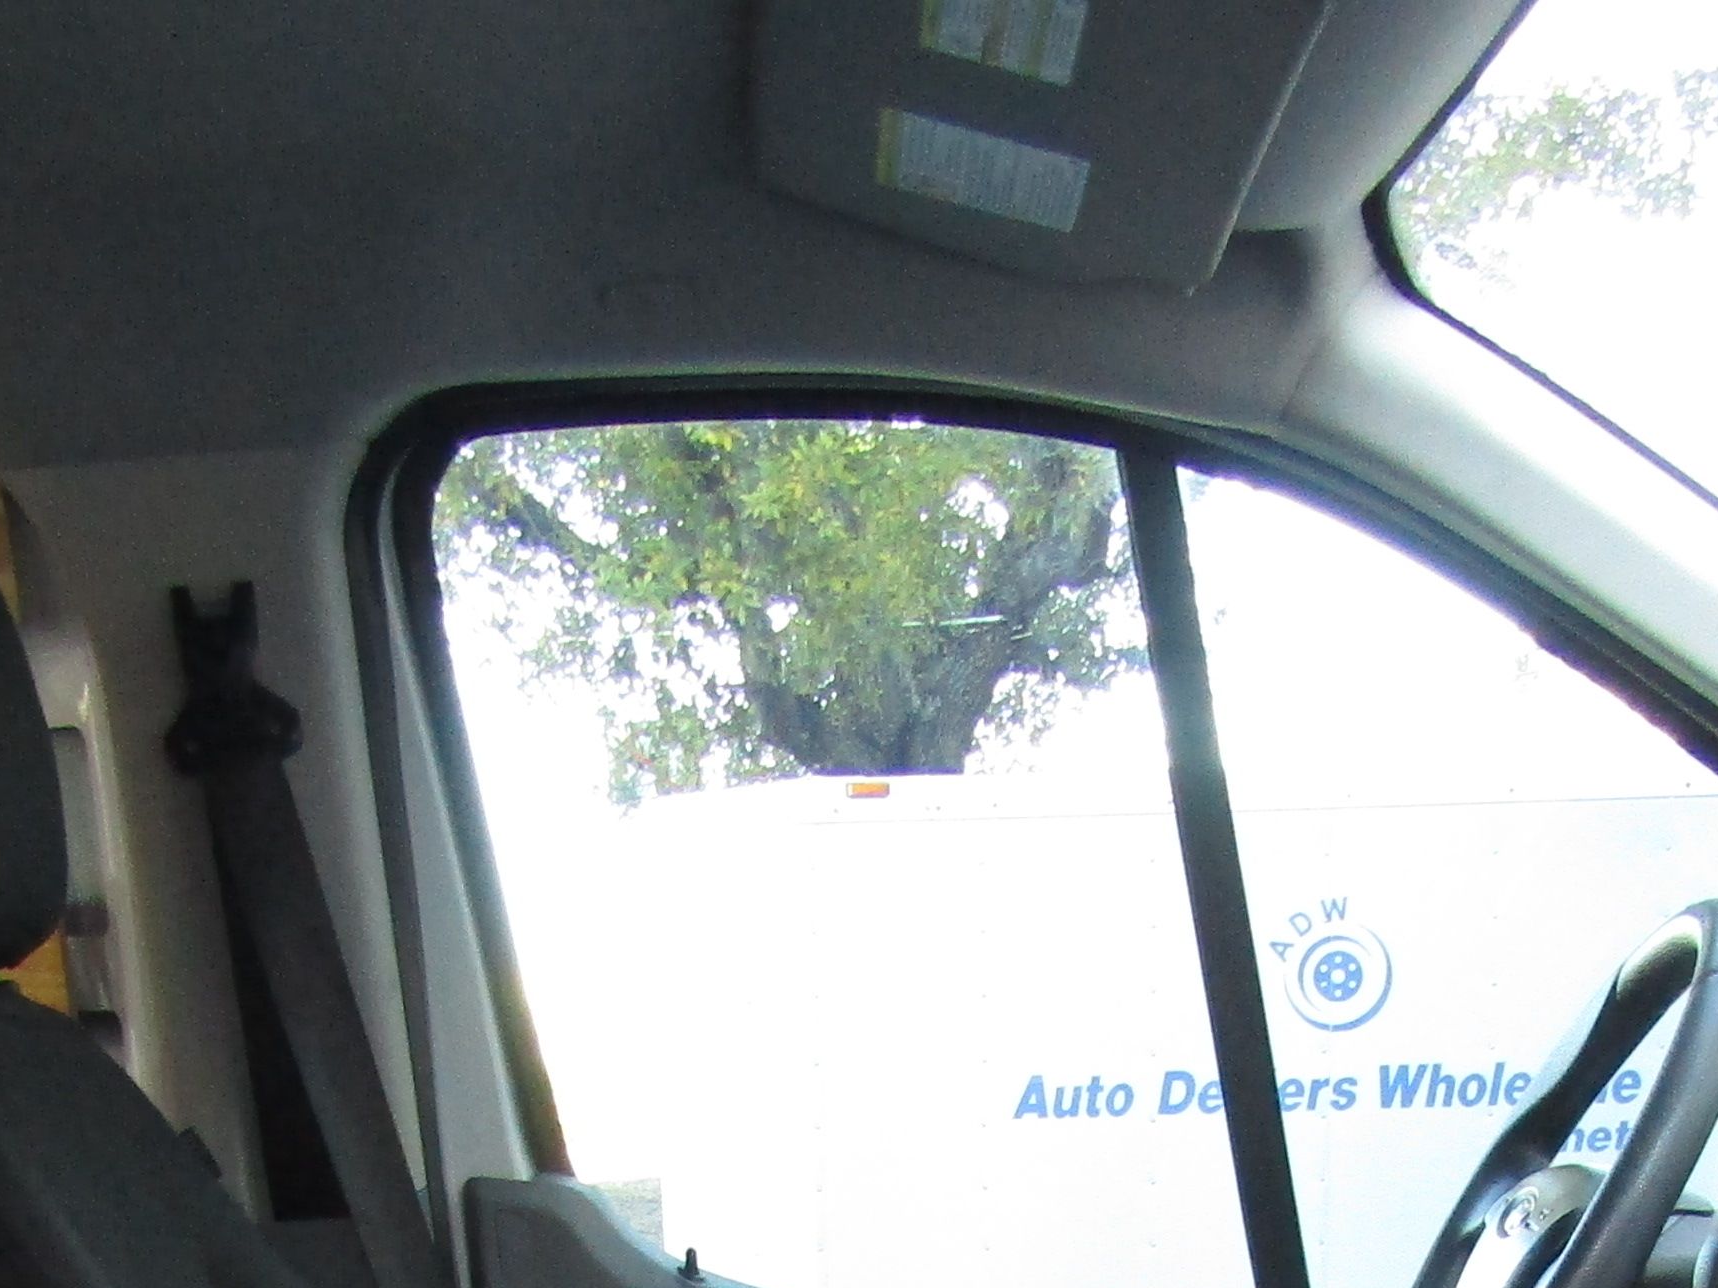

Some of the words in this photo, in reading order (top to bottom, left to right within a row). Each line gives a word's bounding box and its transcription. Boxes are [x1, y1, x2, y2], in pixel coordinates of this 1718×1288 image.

[1268, 896, 1348, 963] ADW
[1014, 1075, 1134, 1119] Auto
[1157, 1069, 1358, 1115] Deers
[1378, 1062, 1642, 1108] Wholee
